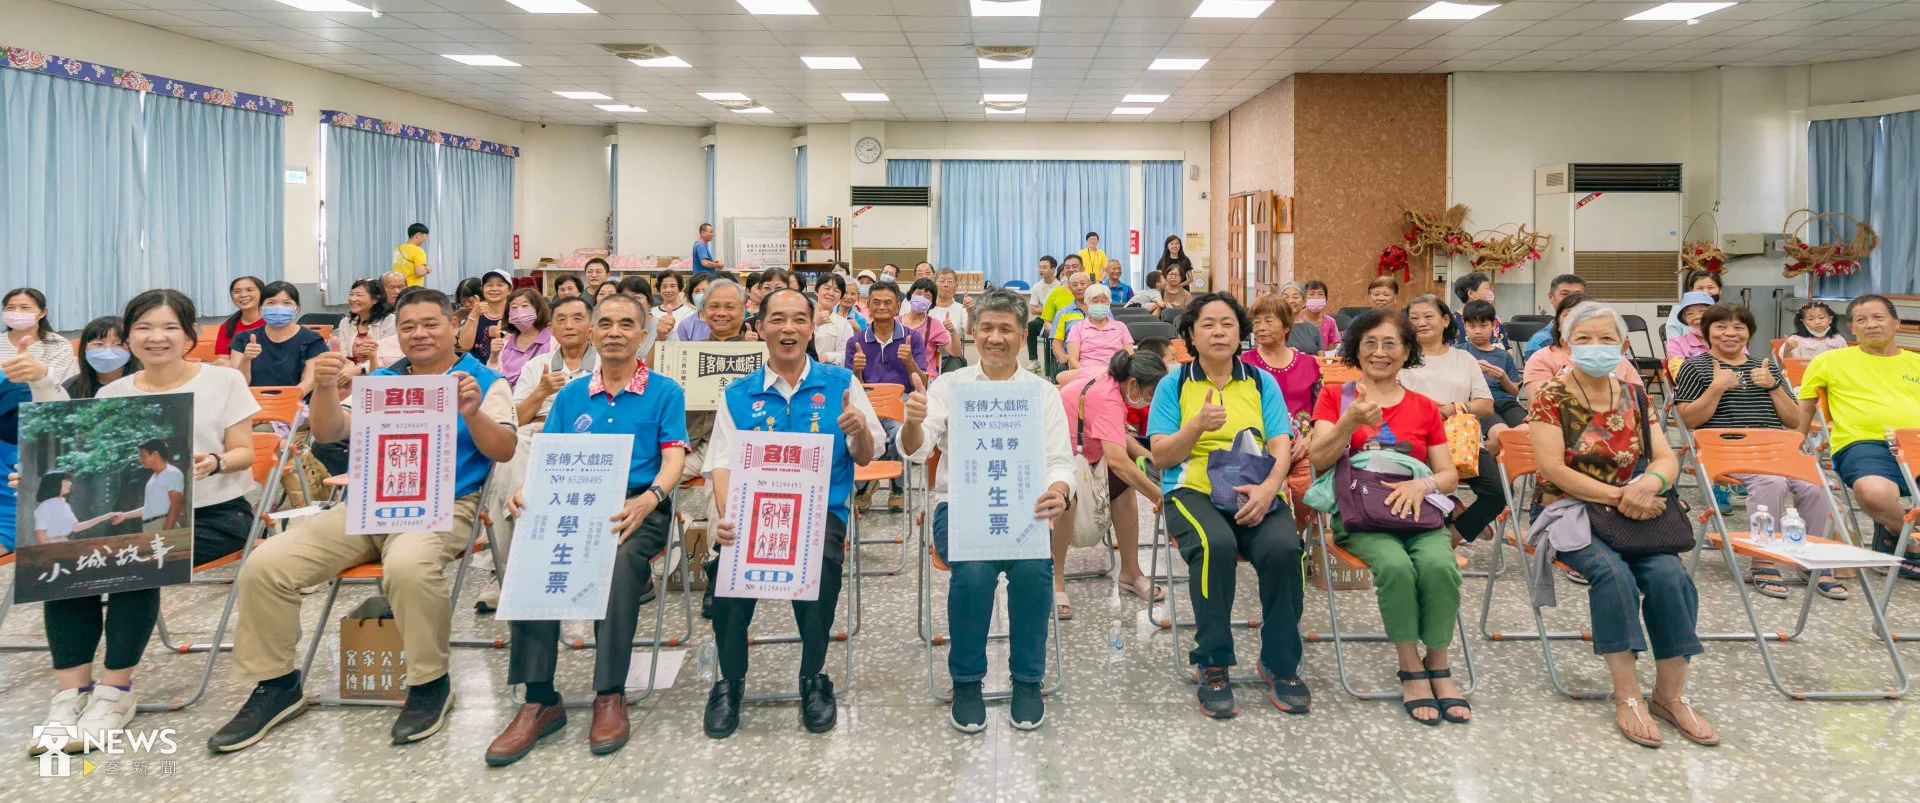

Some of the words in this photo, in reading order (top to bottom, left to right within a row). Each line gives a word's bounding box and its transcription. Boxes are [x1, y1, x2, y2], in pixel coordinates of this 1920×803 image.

[706, 355, 755, 374] 客傳大戲院
[964, 397, 1029, 412] 客傳大戲院
[989, 421, 1022, 430] 85298495
[975, 437, 1019, 450] 入場券
[545, 451, 614, 466] 客傳大戲院
[567, 475, 603, 484] 85298495
[549, 492, 596, 506] 入場券
[987, 459, 1010, 535] 學生票
[37, 533, 175, 582] 小城故事
[545, 515, 579, 594] 學生票
